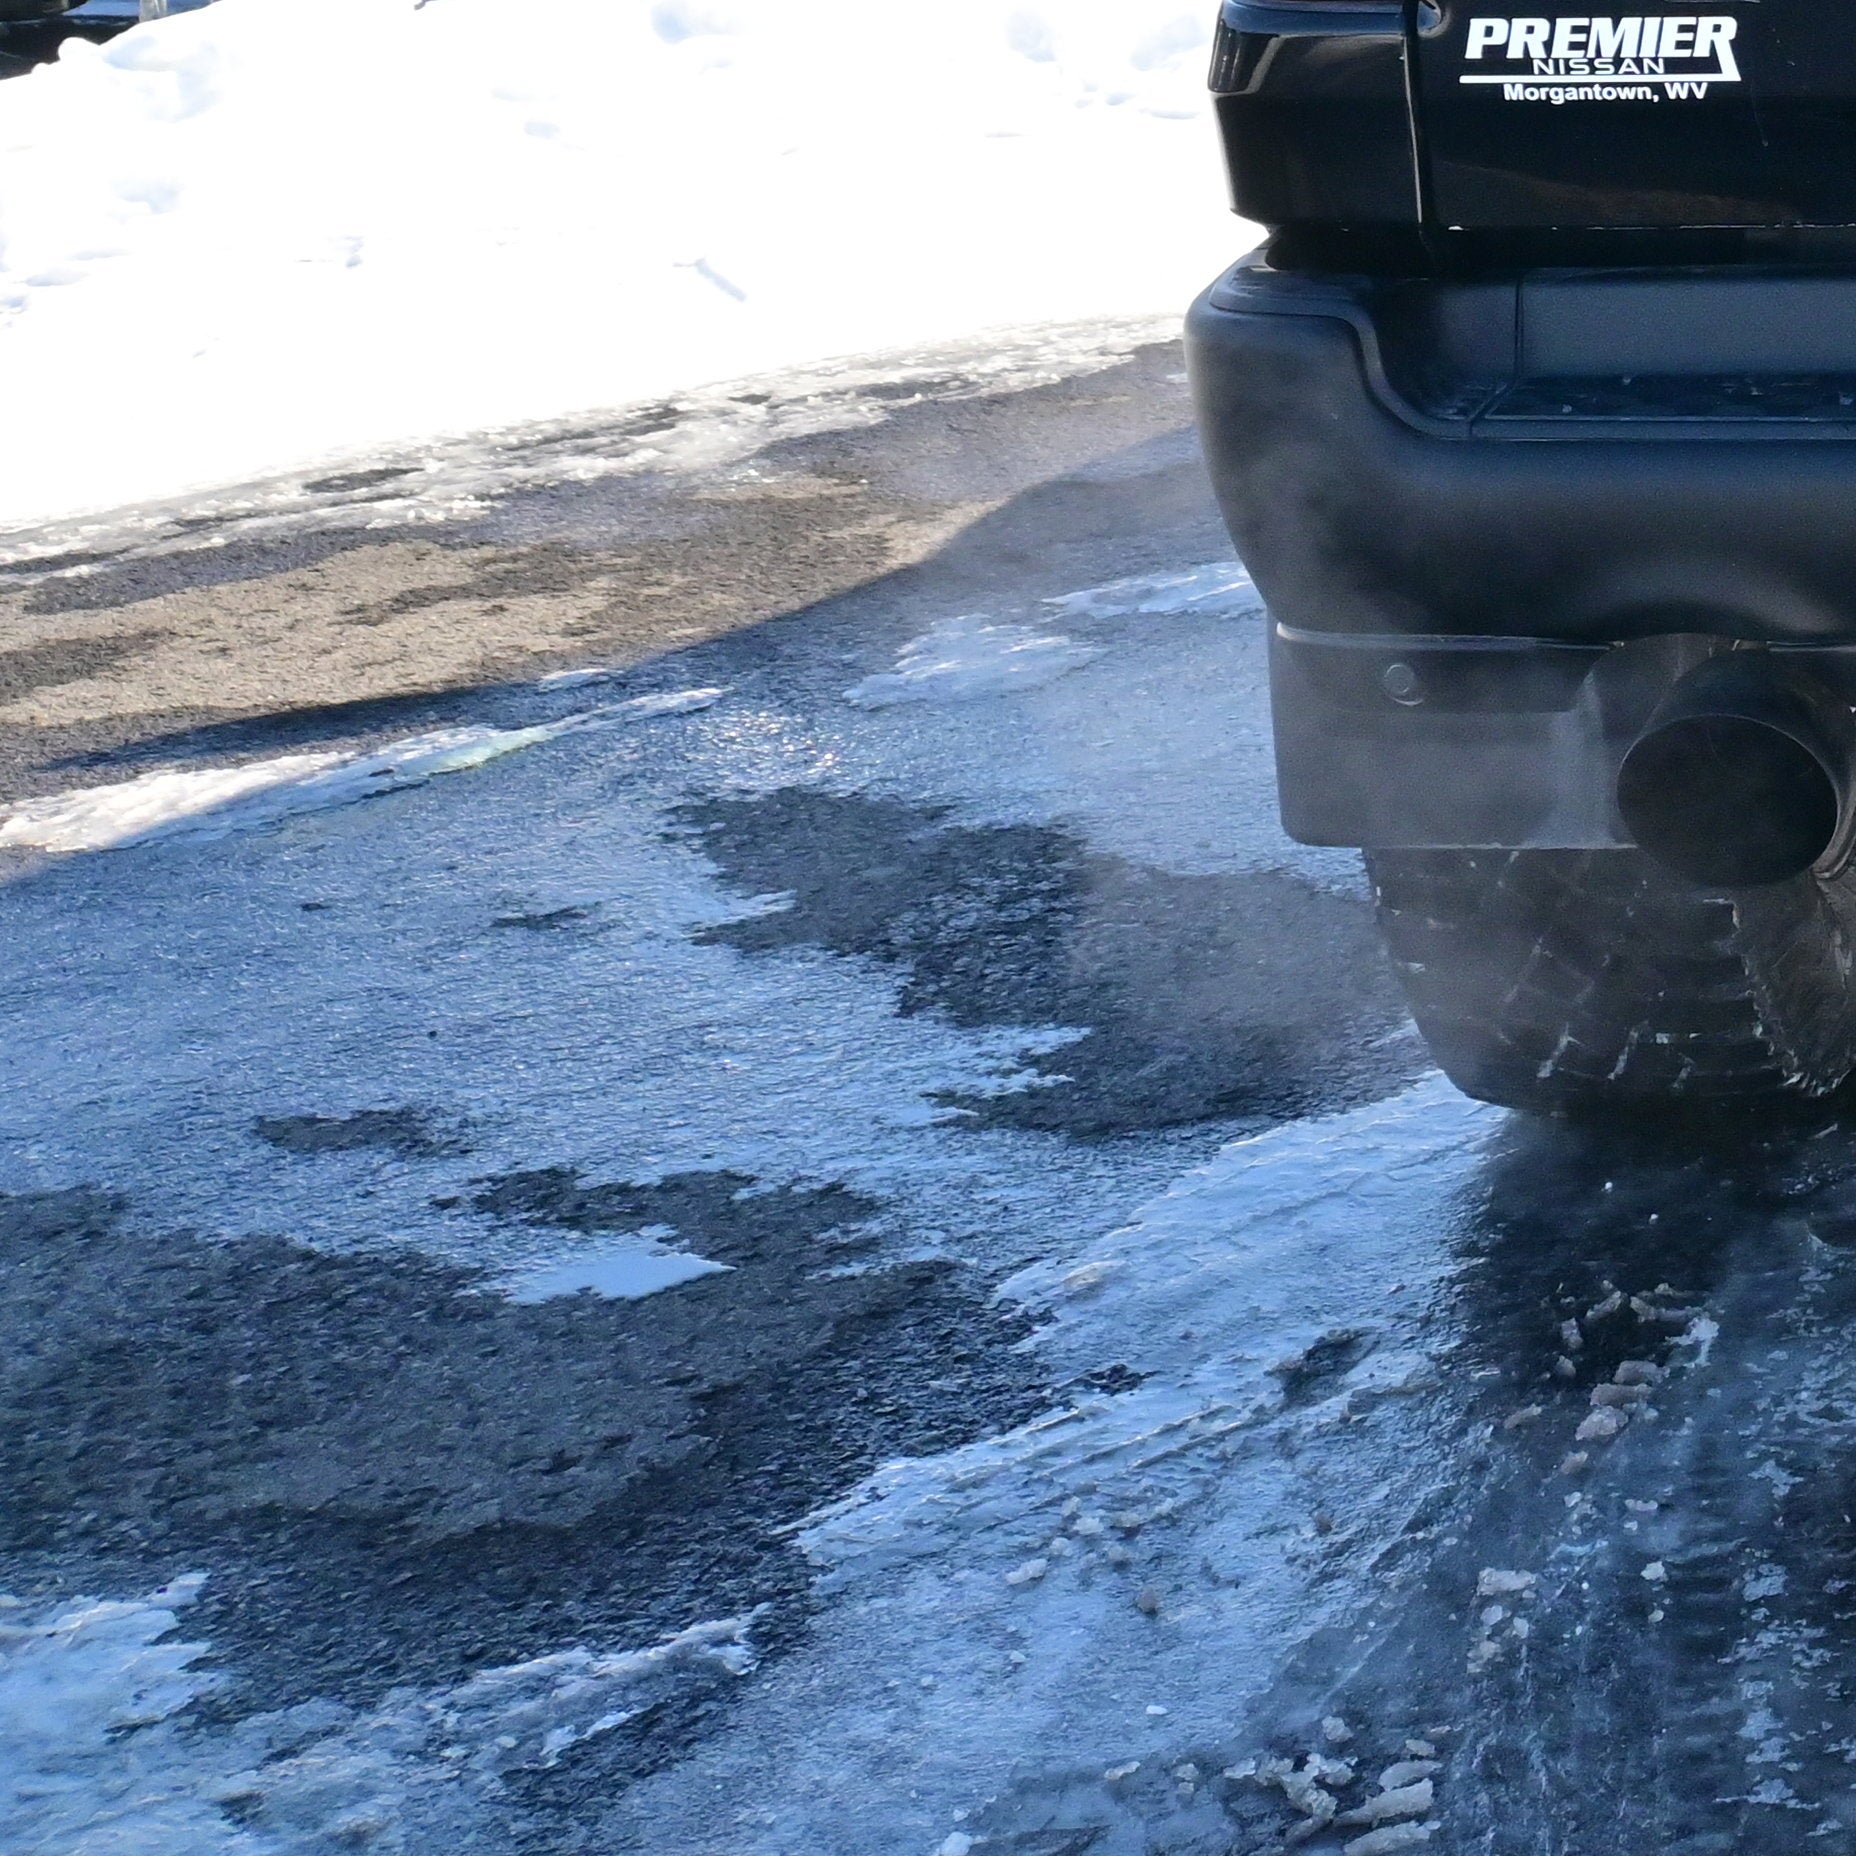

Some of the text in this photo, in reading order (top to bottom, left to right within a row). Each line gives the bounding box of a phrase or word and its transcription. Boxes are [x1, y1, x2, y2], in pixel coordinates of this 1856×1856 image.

[1464, 15, 1741, 61] PREMIER
[1533, 58, 1665, 75] NISSAN
[1503, 82, 1708, 105] Morgantown, WV
